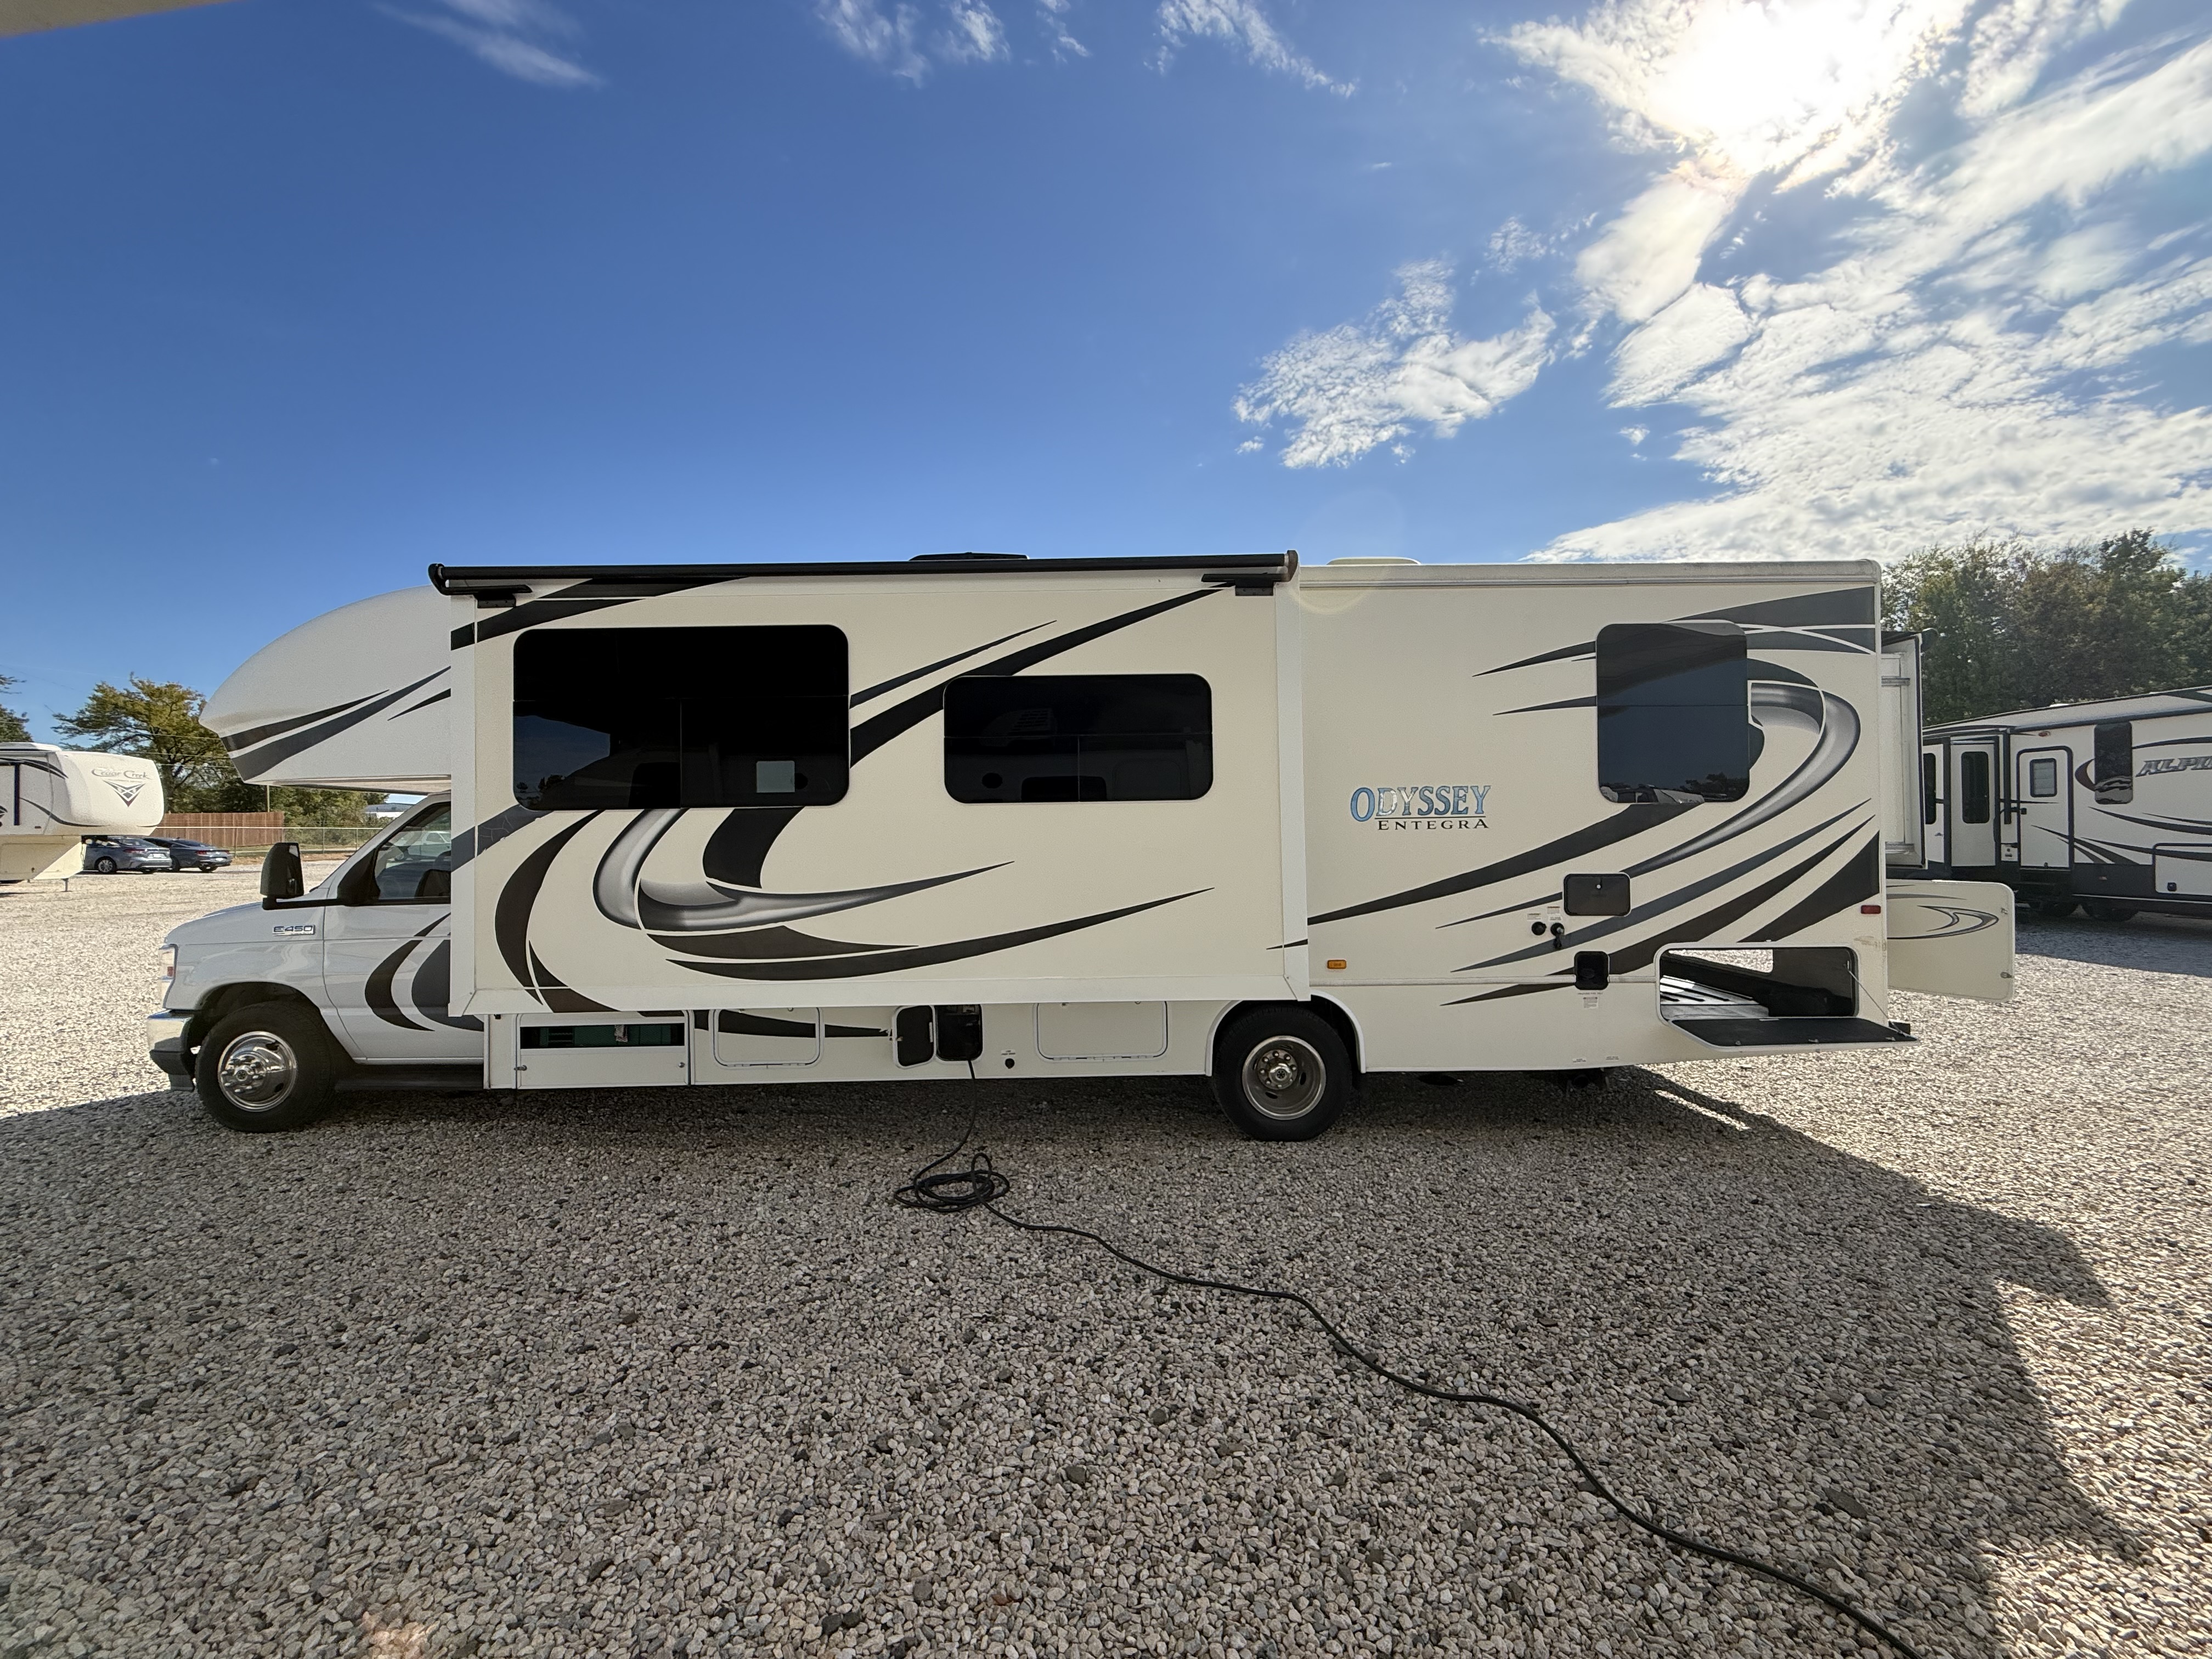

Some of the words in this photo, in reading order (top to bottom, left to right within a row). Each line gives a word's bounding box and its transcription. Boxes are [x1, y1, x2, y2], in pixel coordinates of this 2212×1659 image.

[2135, 755, 2212, 777] ALPI
[123, 770, 152, 780] Creek
[1350, 786, 1491, 822] ODYSSEY
[1378, 819, 1489, 831] ENTEGRA
